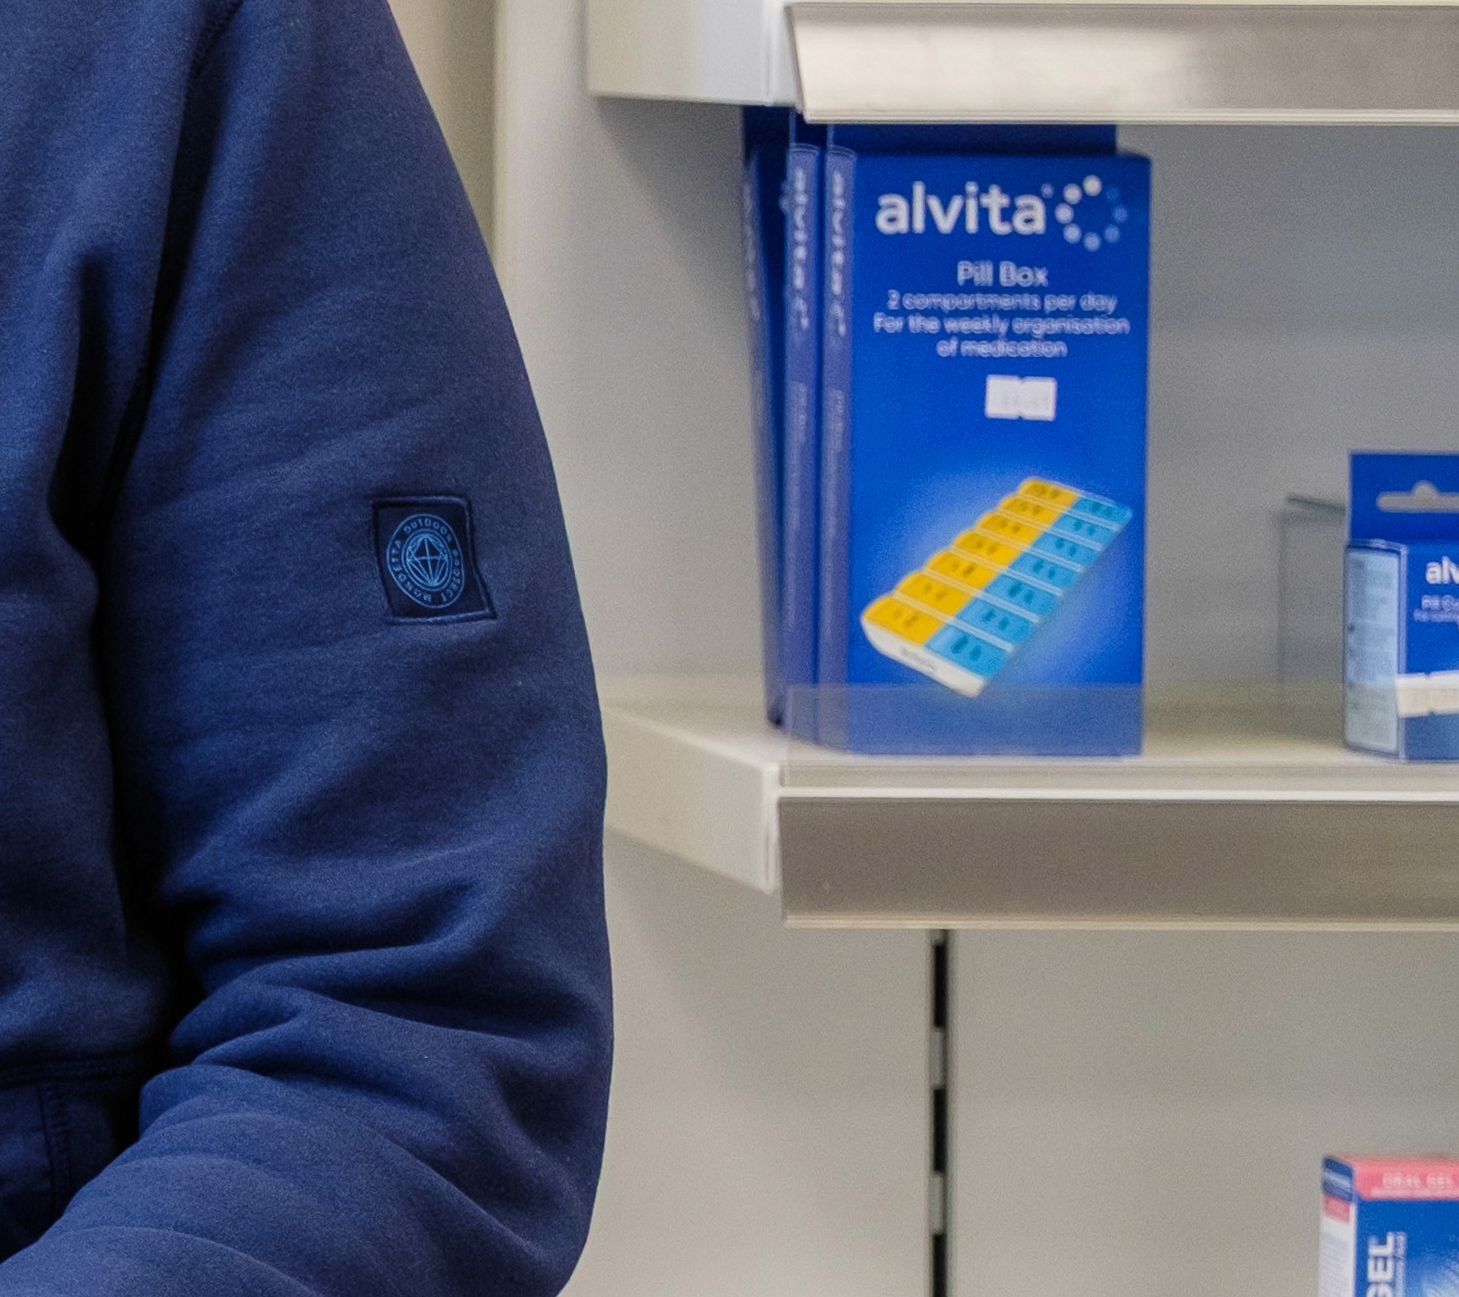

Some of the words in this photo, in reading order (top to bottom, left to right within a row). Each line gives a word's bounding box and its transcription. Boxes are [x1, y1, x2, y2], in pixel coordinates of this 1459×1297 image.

[874, 180, 1047, 235] alvita
[956, 259, 994, 287] Pill
[998, 260, 1049, 287] Box
[902, 291, 1042, 314] compartments
[1043, 292, 1077, 315] per
[1079, 289, 1119, 315] day
[873, 311, 904, 334] For
[907, 312, 942, 334] the
[943, 312, 1010, 337] weekly
[1011, 314, 1131, 339] organisation
[935, 335, 959, 358] of
[959, 337, 1068, 359] medication
